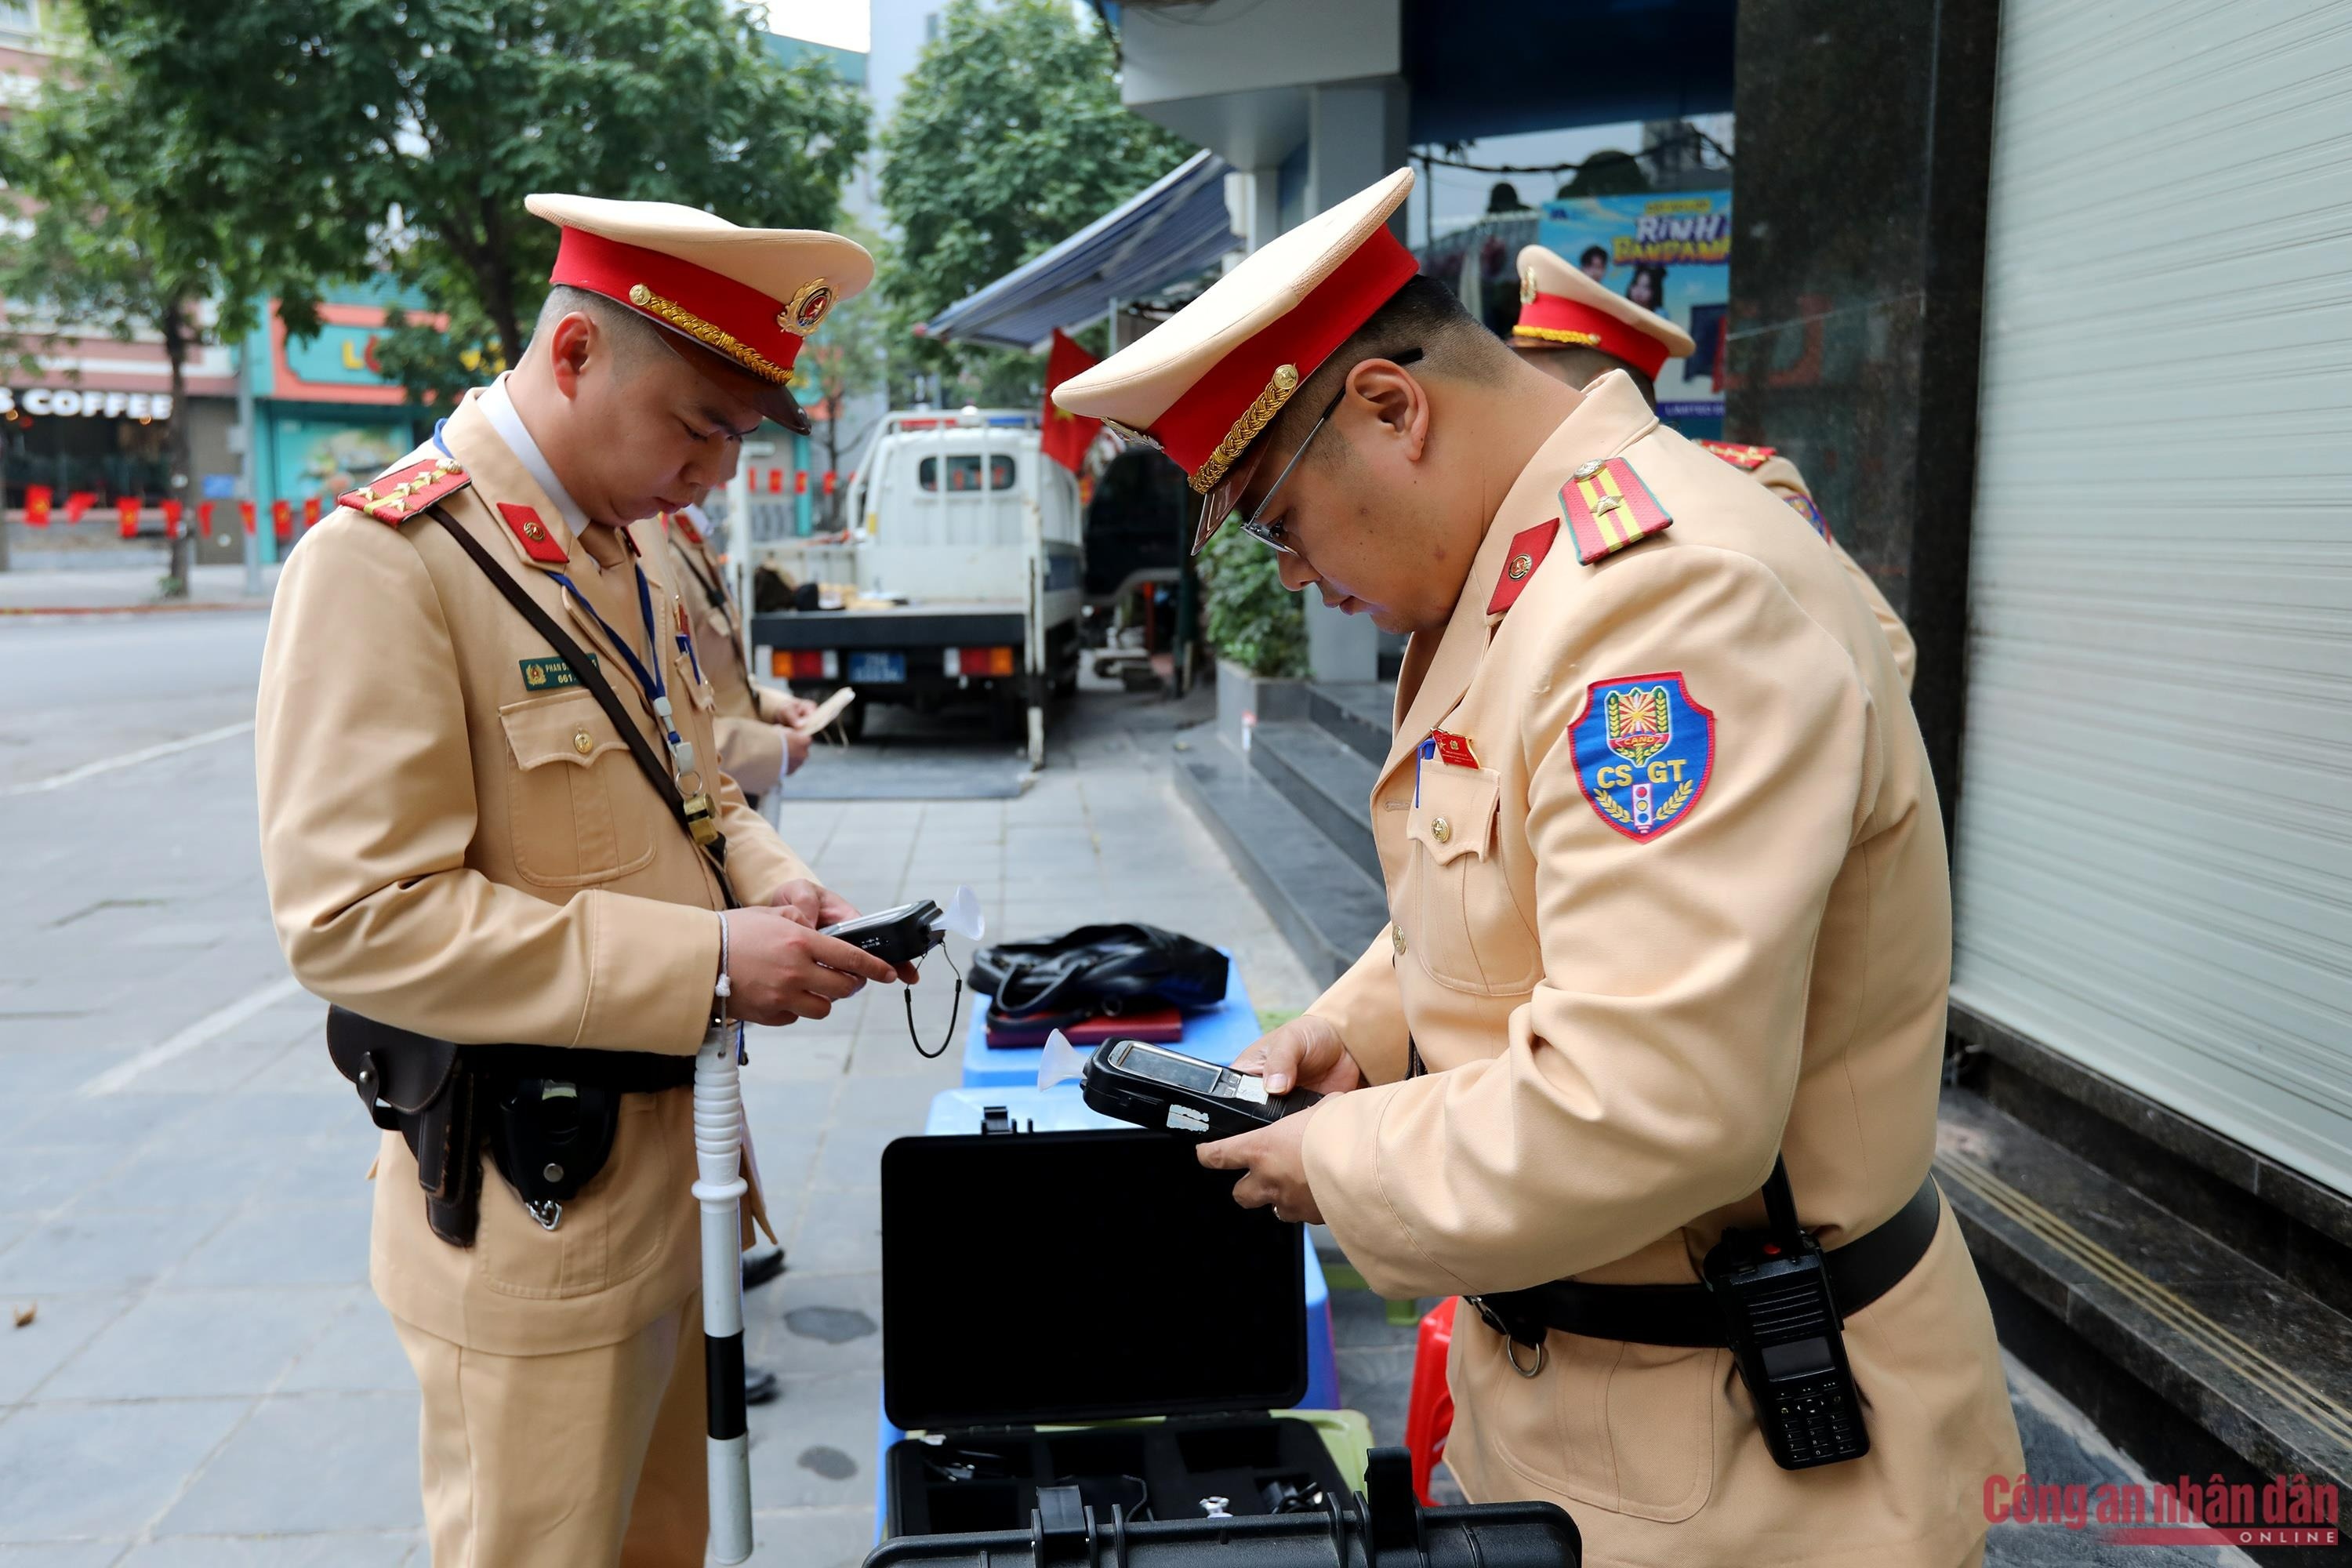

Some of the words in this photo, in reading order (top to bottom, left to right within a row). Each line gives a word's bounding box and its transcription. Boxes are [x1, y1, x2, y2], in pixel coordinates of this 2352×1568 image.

[22, 388, 173, 419] COFFEE
[545, 663, 561, 673] PHAN
[1624, 736, 1655, 745] CAND
[1597, 765, 1633, 789] CS
[1647, 759, 1687, 783] GT
